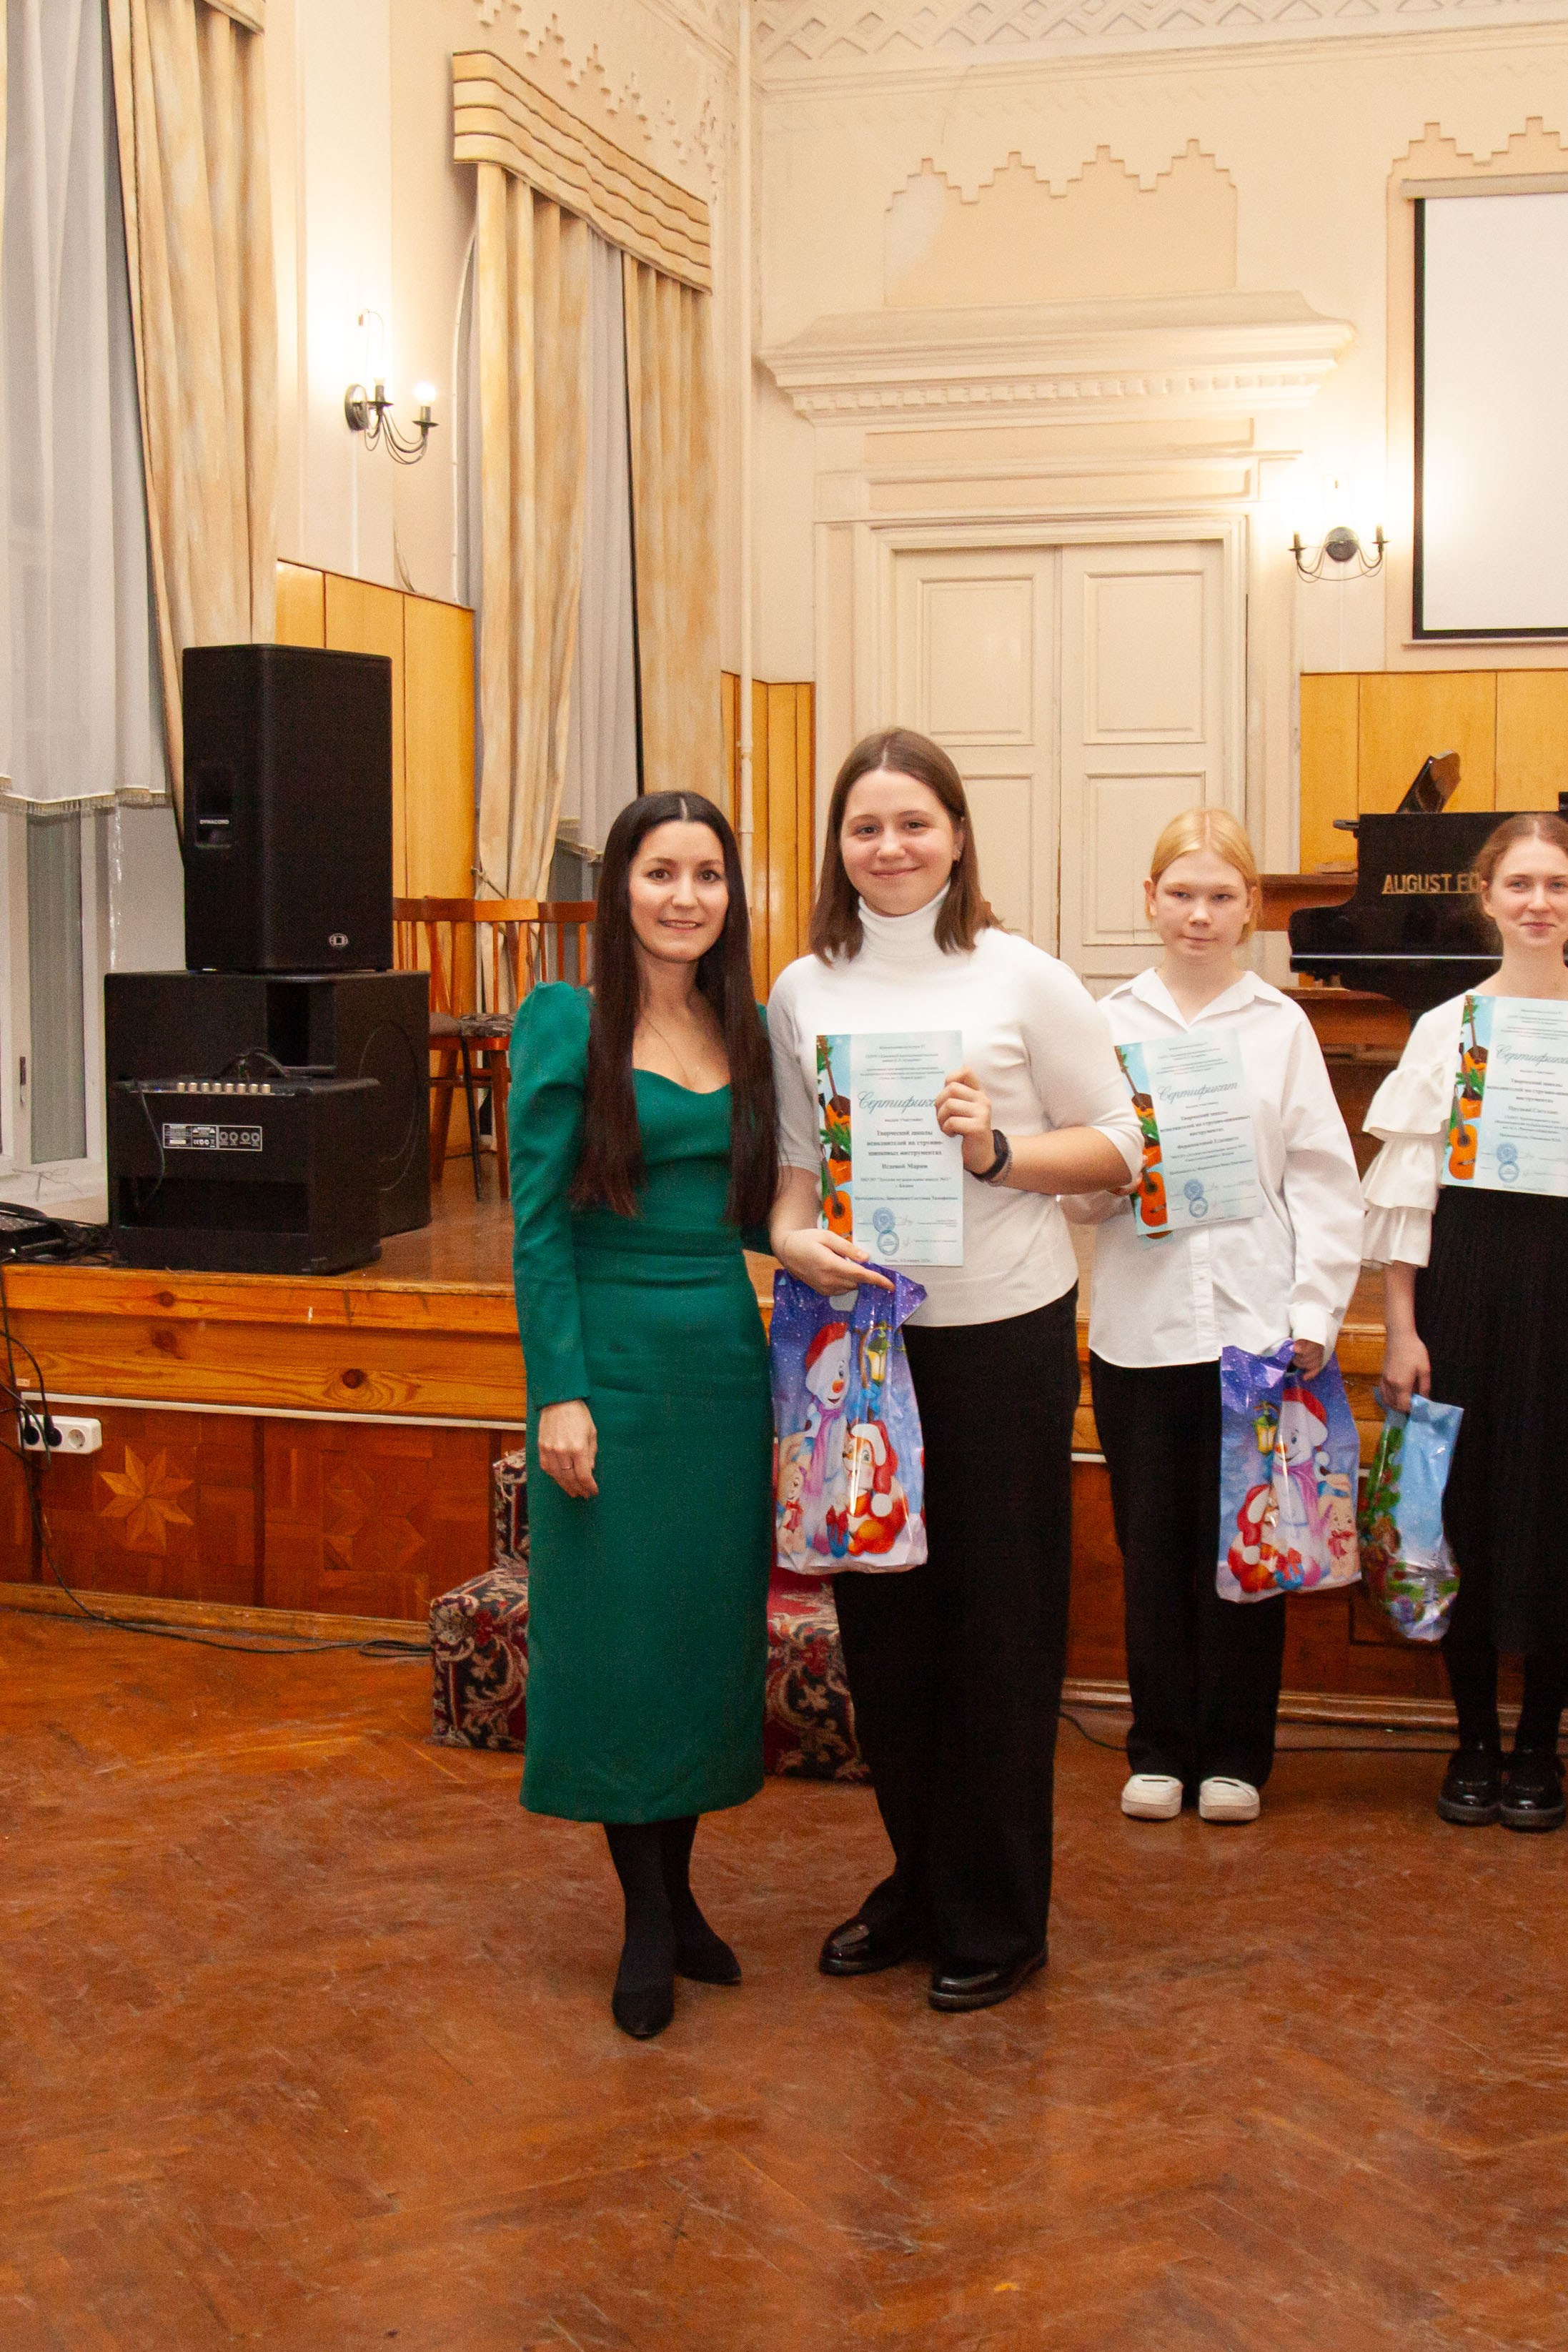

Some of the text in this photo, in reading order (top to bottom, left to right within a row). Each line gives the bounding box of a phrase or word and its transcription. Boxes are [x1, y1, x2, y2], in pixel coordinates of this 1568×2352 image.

[1382, 874, 1452, 893] AUGUST
[1495, 1043, 1568, 1066] Сертифика
[857, 1091, 936, 1114] Сертифика
